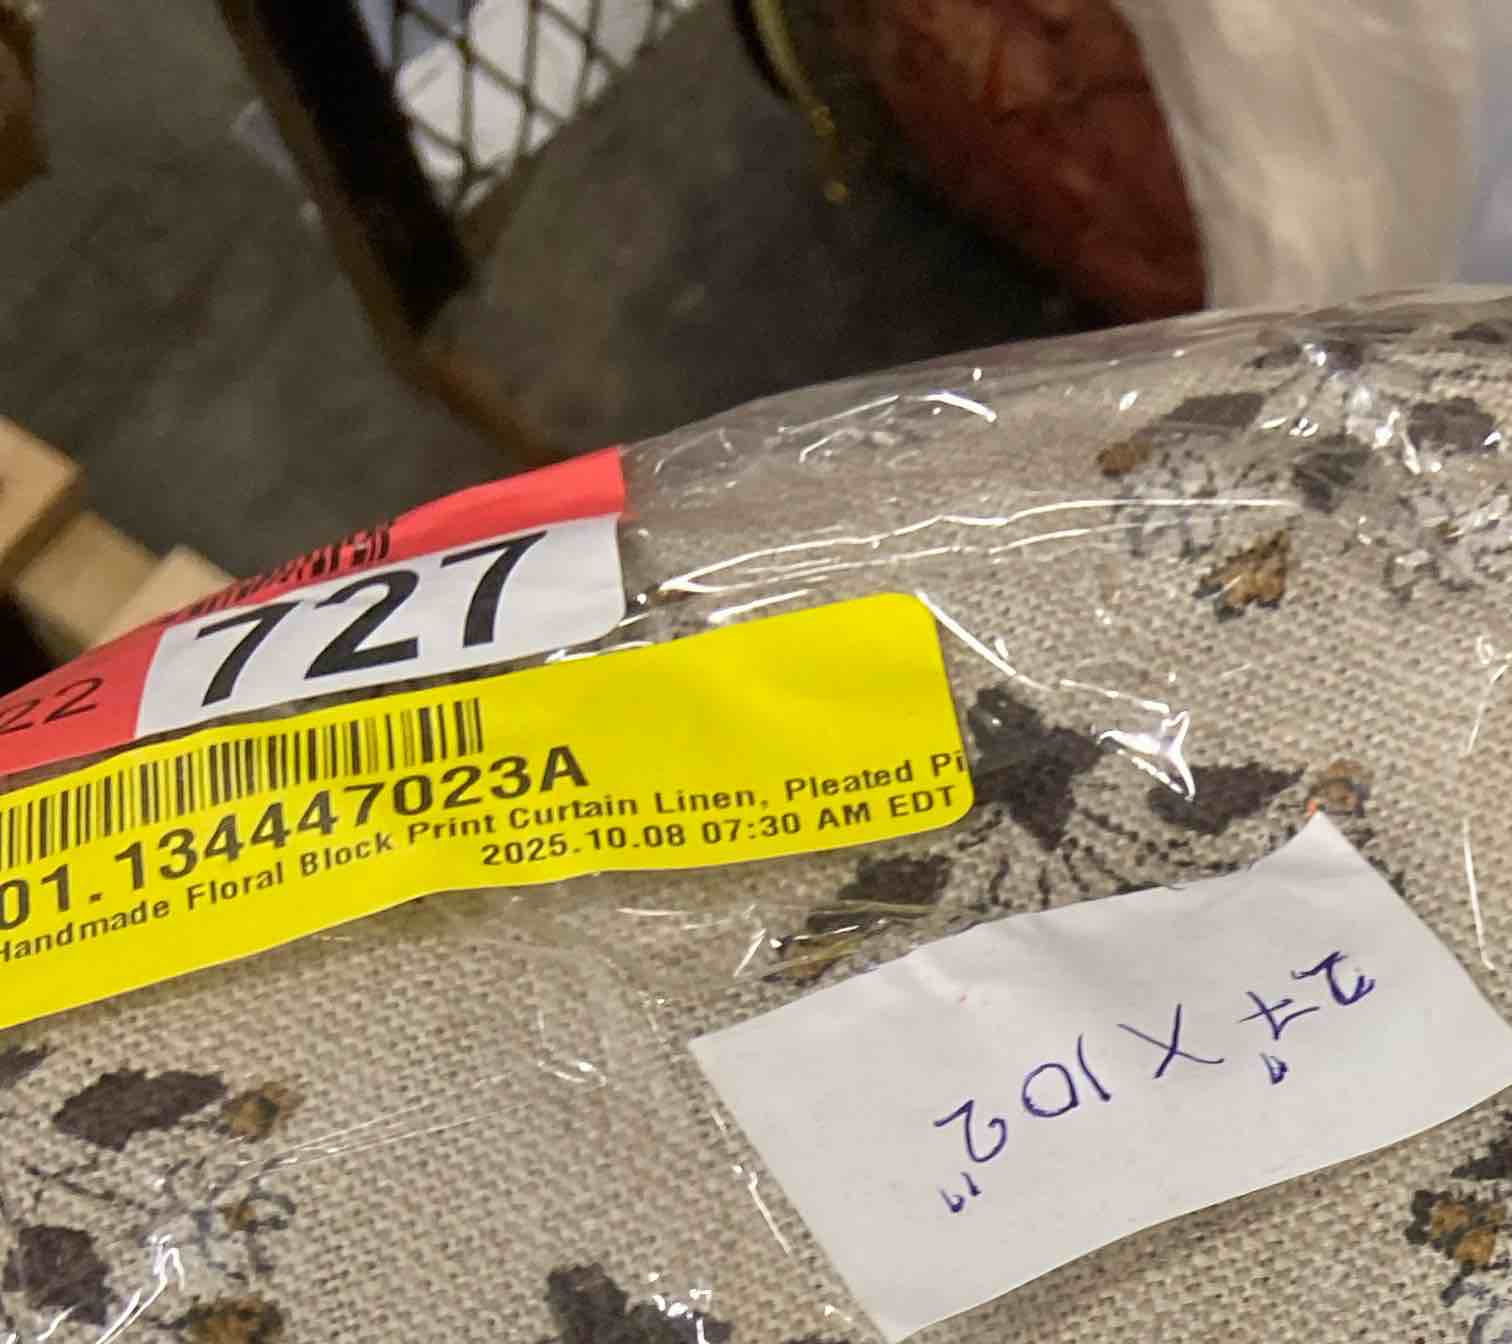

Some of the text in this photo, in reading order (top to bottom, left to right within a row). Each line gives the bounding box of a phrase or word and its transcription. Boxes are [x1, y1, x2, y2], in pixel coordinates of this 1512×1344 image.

[195, 530, 548, 708] 727
[186, 862, 285, 911] Floral
[299, 831, 394, 878] Block
[407, 814, 497, 845] Print
[508, 794, 639, 830] Curtain
[654, 788, 769, 815] Linen,
[784, 759, 914, 801] Pleated
[480, 783, 956, 867] 2025.10.08 07:30 AM EDT
